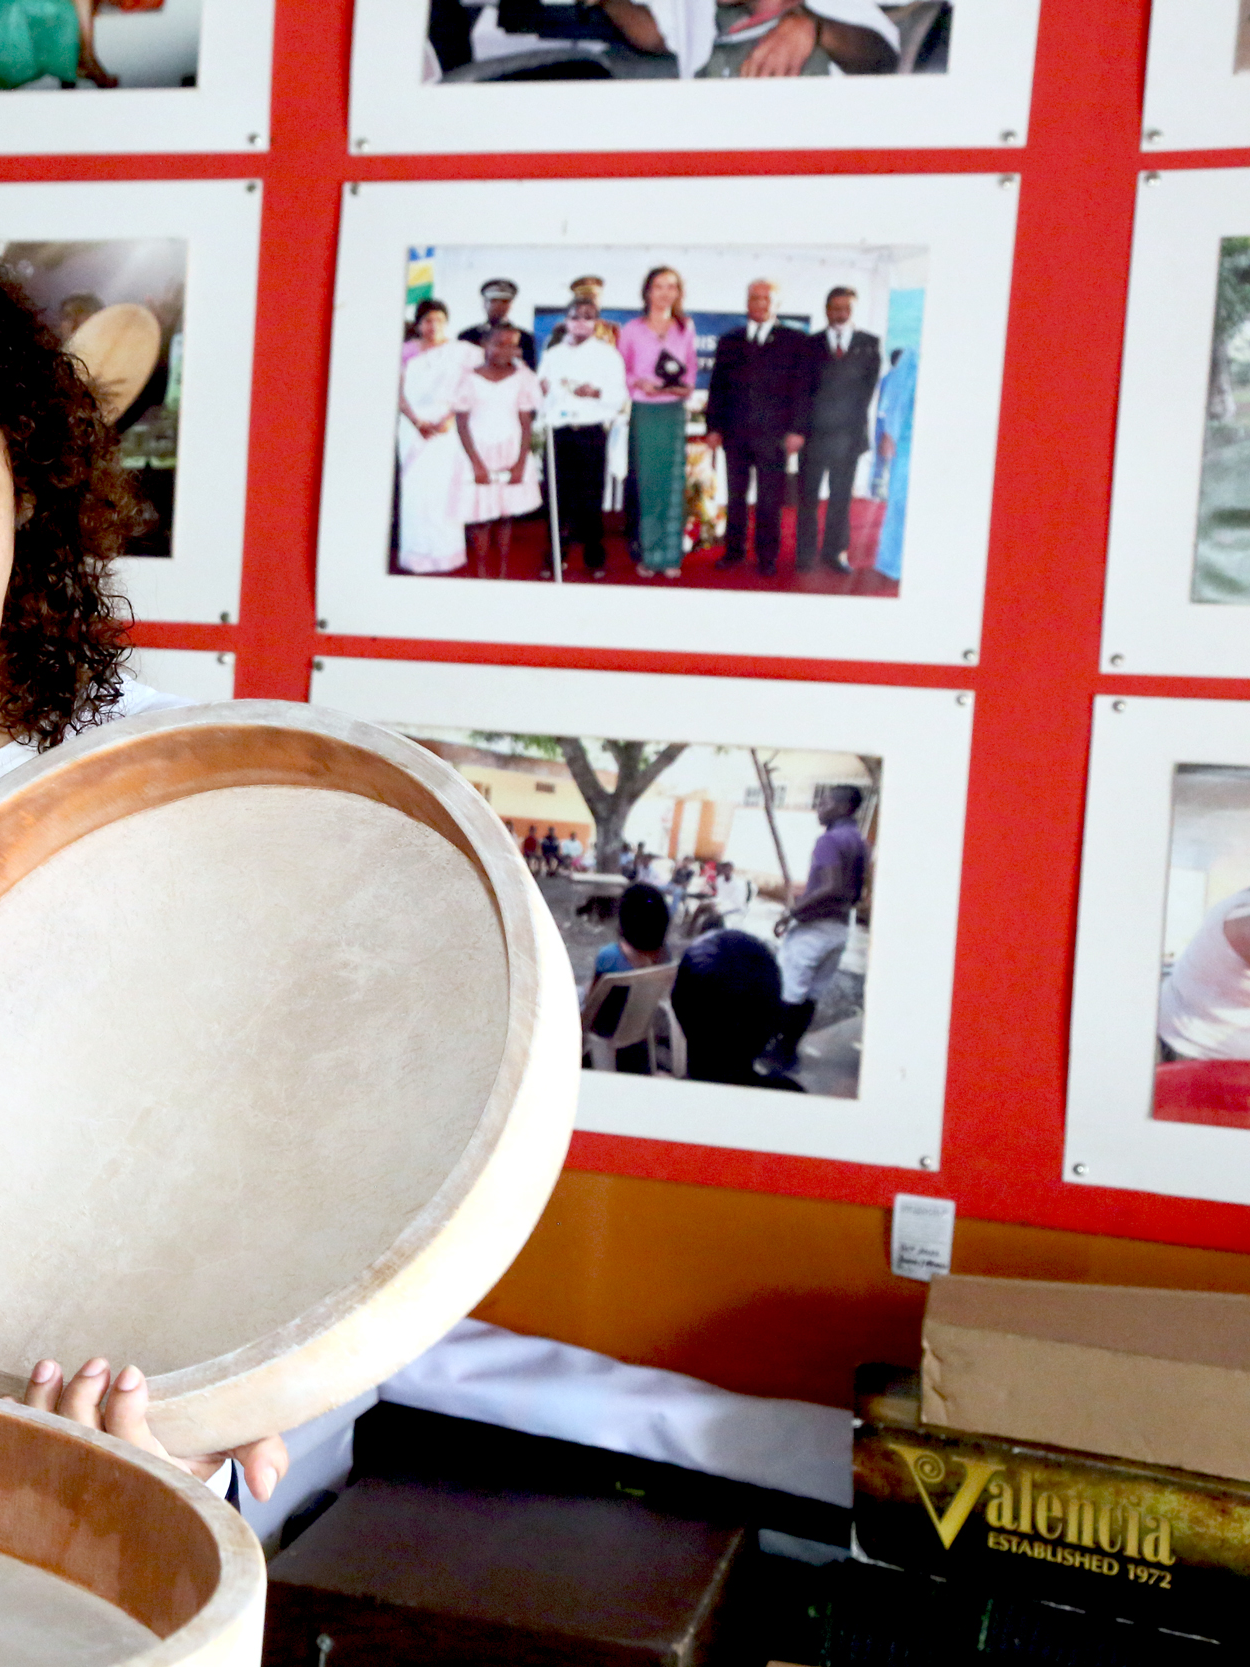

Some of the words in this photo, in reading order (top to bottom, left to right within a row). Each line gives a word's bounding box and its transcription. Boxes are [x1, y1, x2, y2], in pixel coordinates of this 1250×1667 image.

[889, 1444, 1176, 1566] Valencia
[987, 1531, 1120, 1576] ESTABLISHED
[1127, 1563, 1172, 1589] 1972
